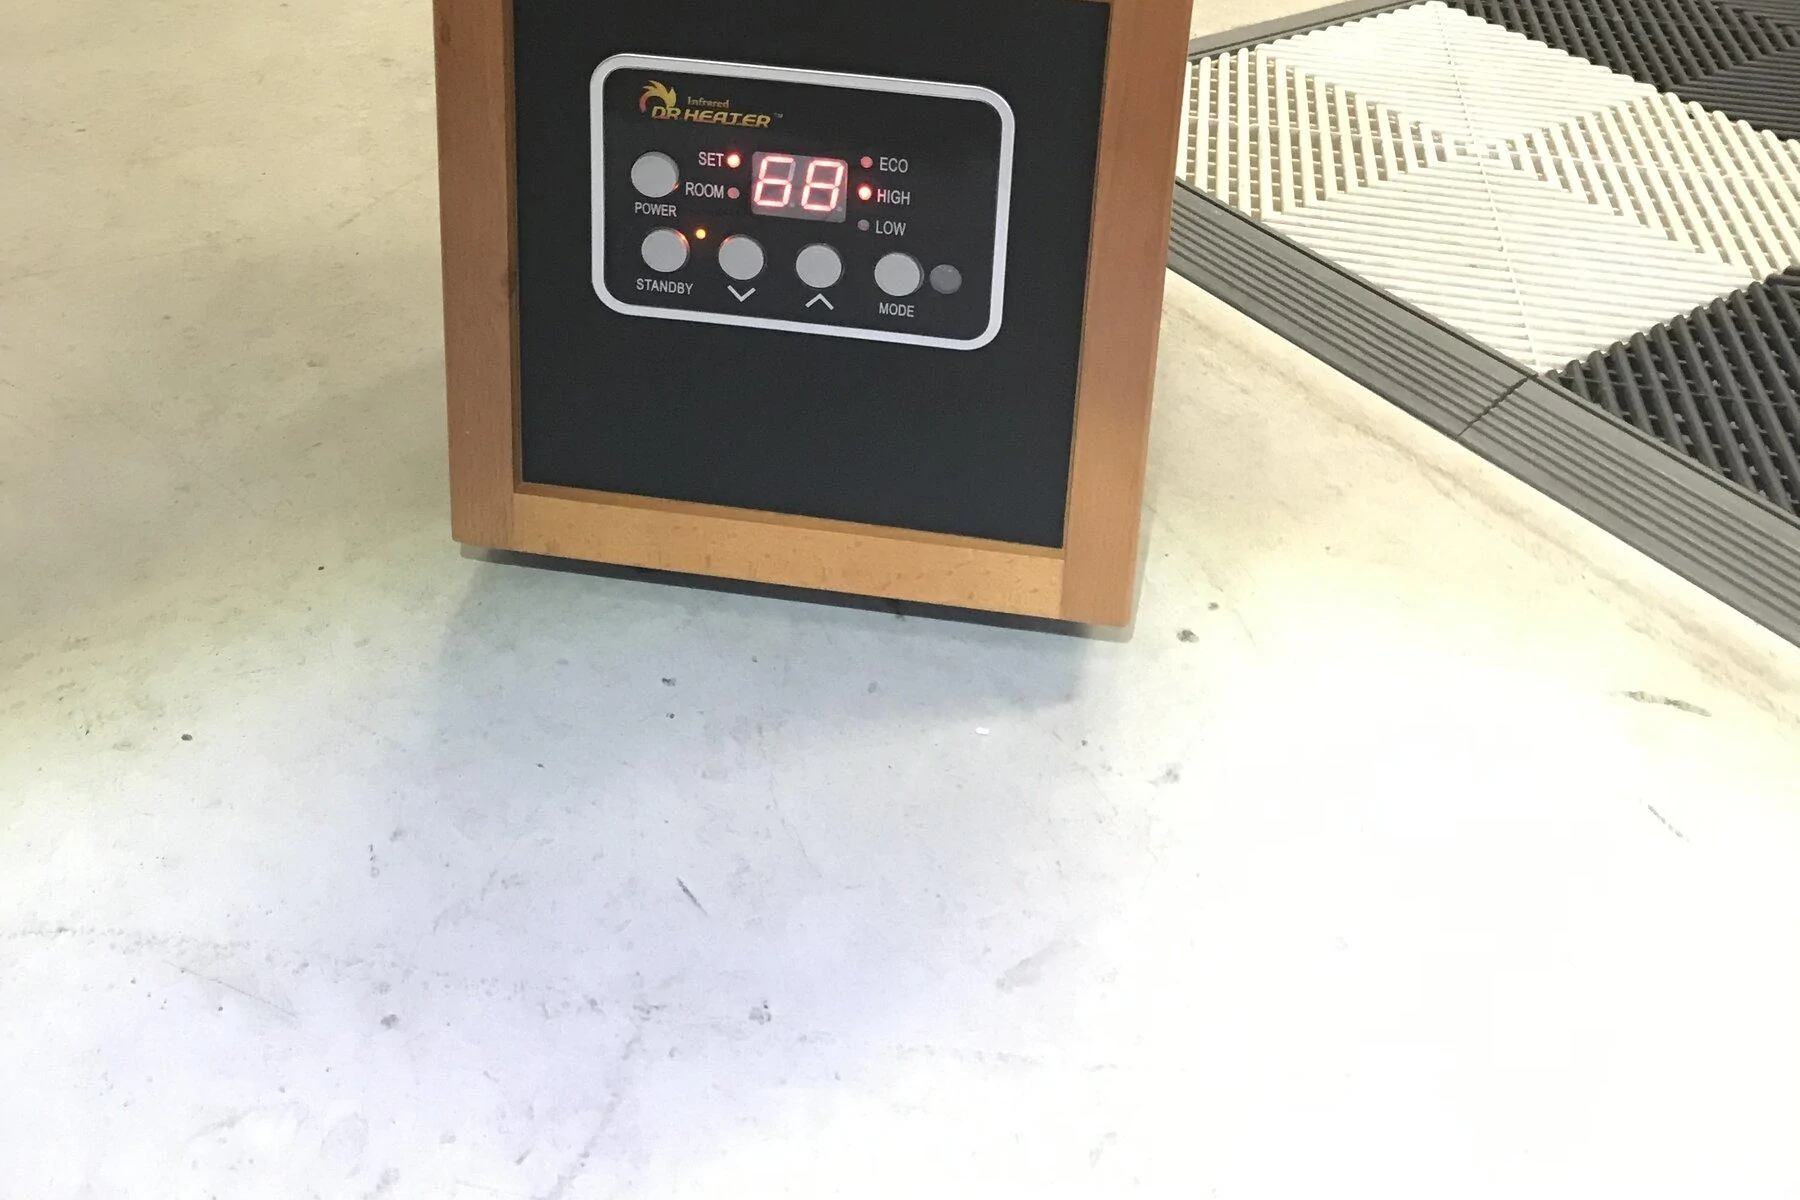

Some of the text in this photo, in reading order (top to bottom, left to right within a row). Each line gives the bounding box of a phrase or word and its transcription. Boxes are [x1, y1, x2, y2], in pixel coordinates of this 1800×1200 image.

[687, 96, 730, 109] Infrared
[652, 106, 772, 129] DR HEATER
[698, 151, 725, 167] SET
[879, 157, 909, 174] ECO
[685, 182, 725, 199] ROOM
[753, 155, 844, 211] 68
[877, 189, 911, 206] HIGH
[634, 201, 677, 217] POWER
[875, 220, 906, 237] LOW
[636, 278, 694, 296] STANDBY
[878, 303, 915, 318] MODE
